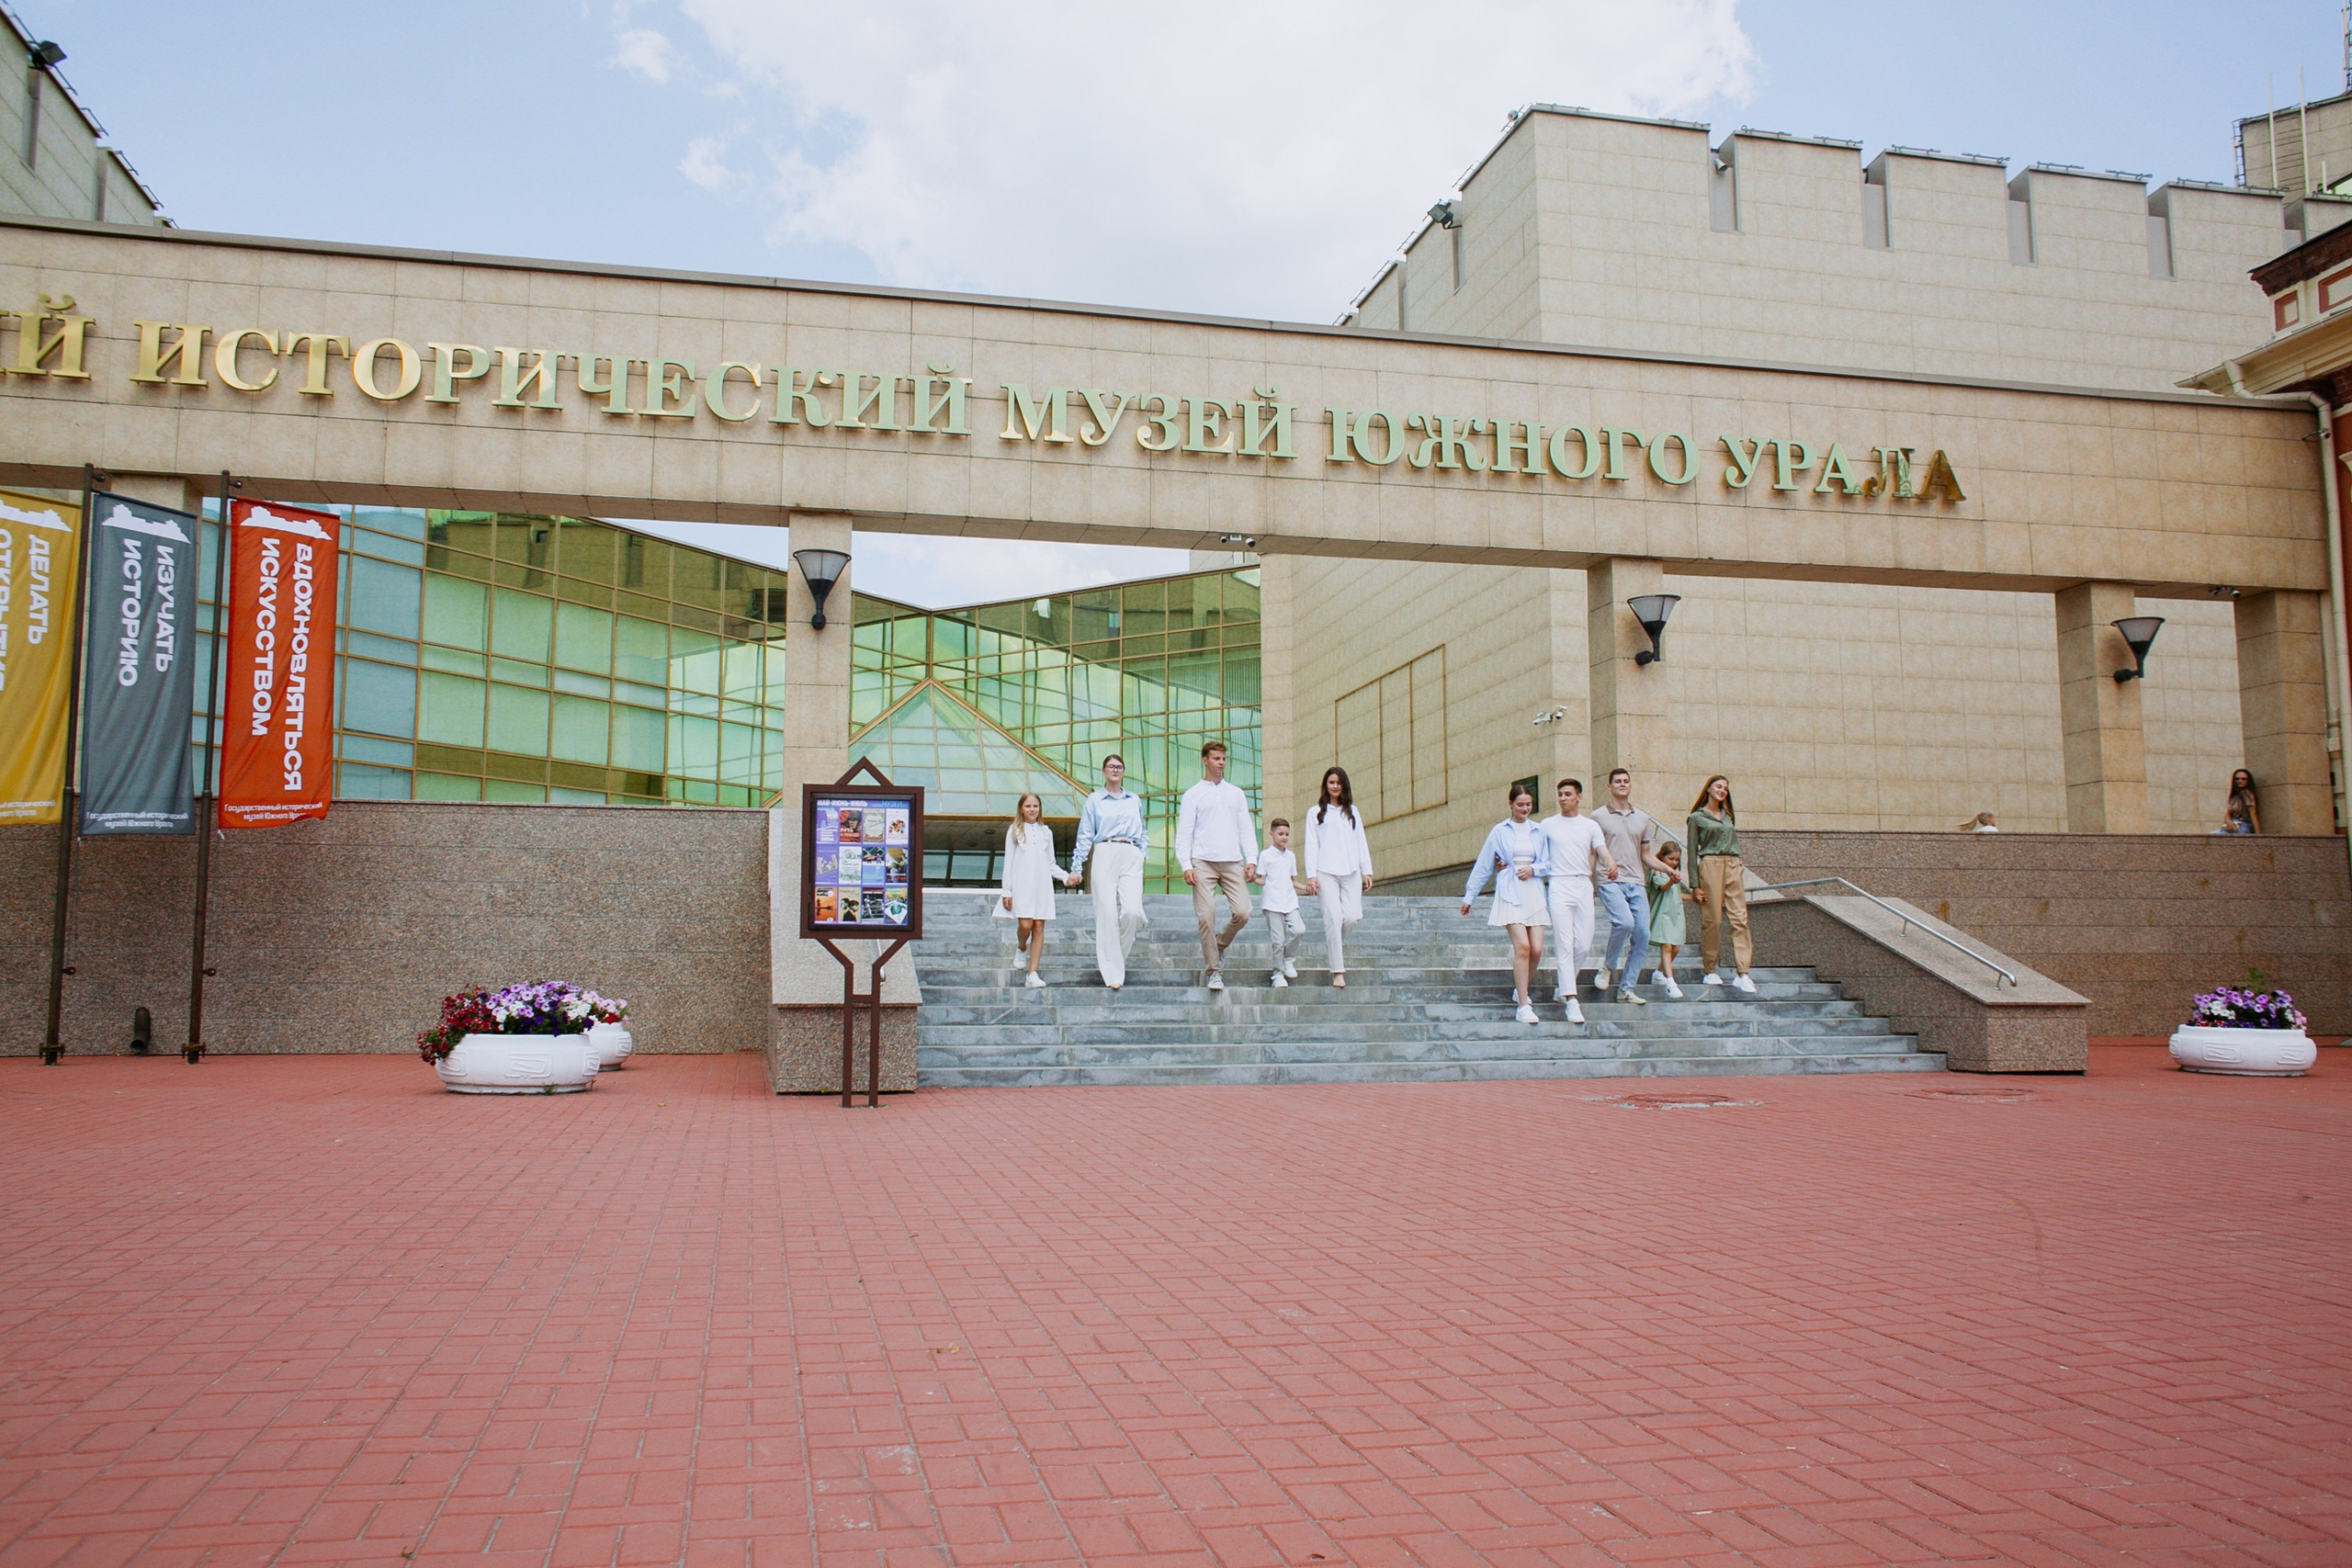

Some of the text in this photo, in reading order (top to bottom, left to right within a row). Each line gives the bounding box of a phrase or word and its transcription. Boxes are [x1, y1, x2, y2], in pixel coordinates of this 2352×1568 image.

[130, 319, 973, 436] ИСТОРИЧЕСКИЙ
[1000, 381, 1298, 459] МУЗЕЙ
[1325, 406, 1700, 486] ЮЖНОГО
[1720, 434, 1967, 502] УРАЛА
[28, 534, 50, 645] ДЕЛАТЬ
[119, 537, 141, 687] ИСТОРИЮ
[155, 545, 175, 672] ИЗУЧАТЬ
[252, 536, 280, 736] ИСКУССТВОМ
[283, 542, 312, 791] ВДОХНОВЛЯТЬСЯ
